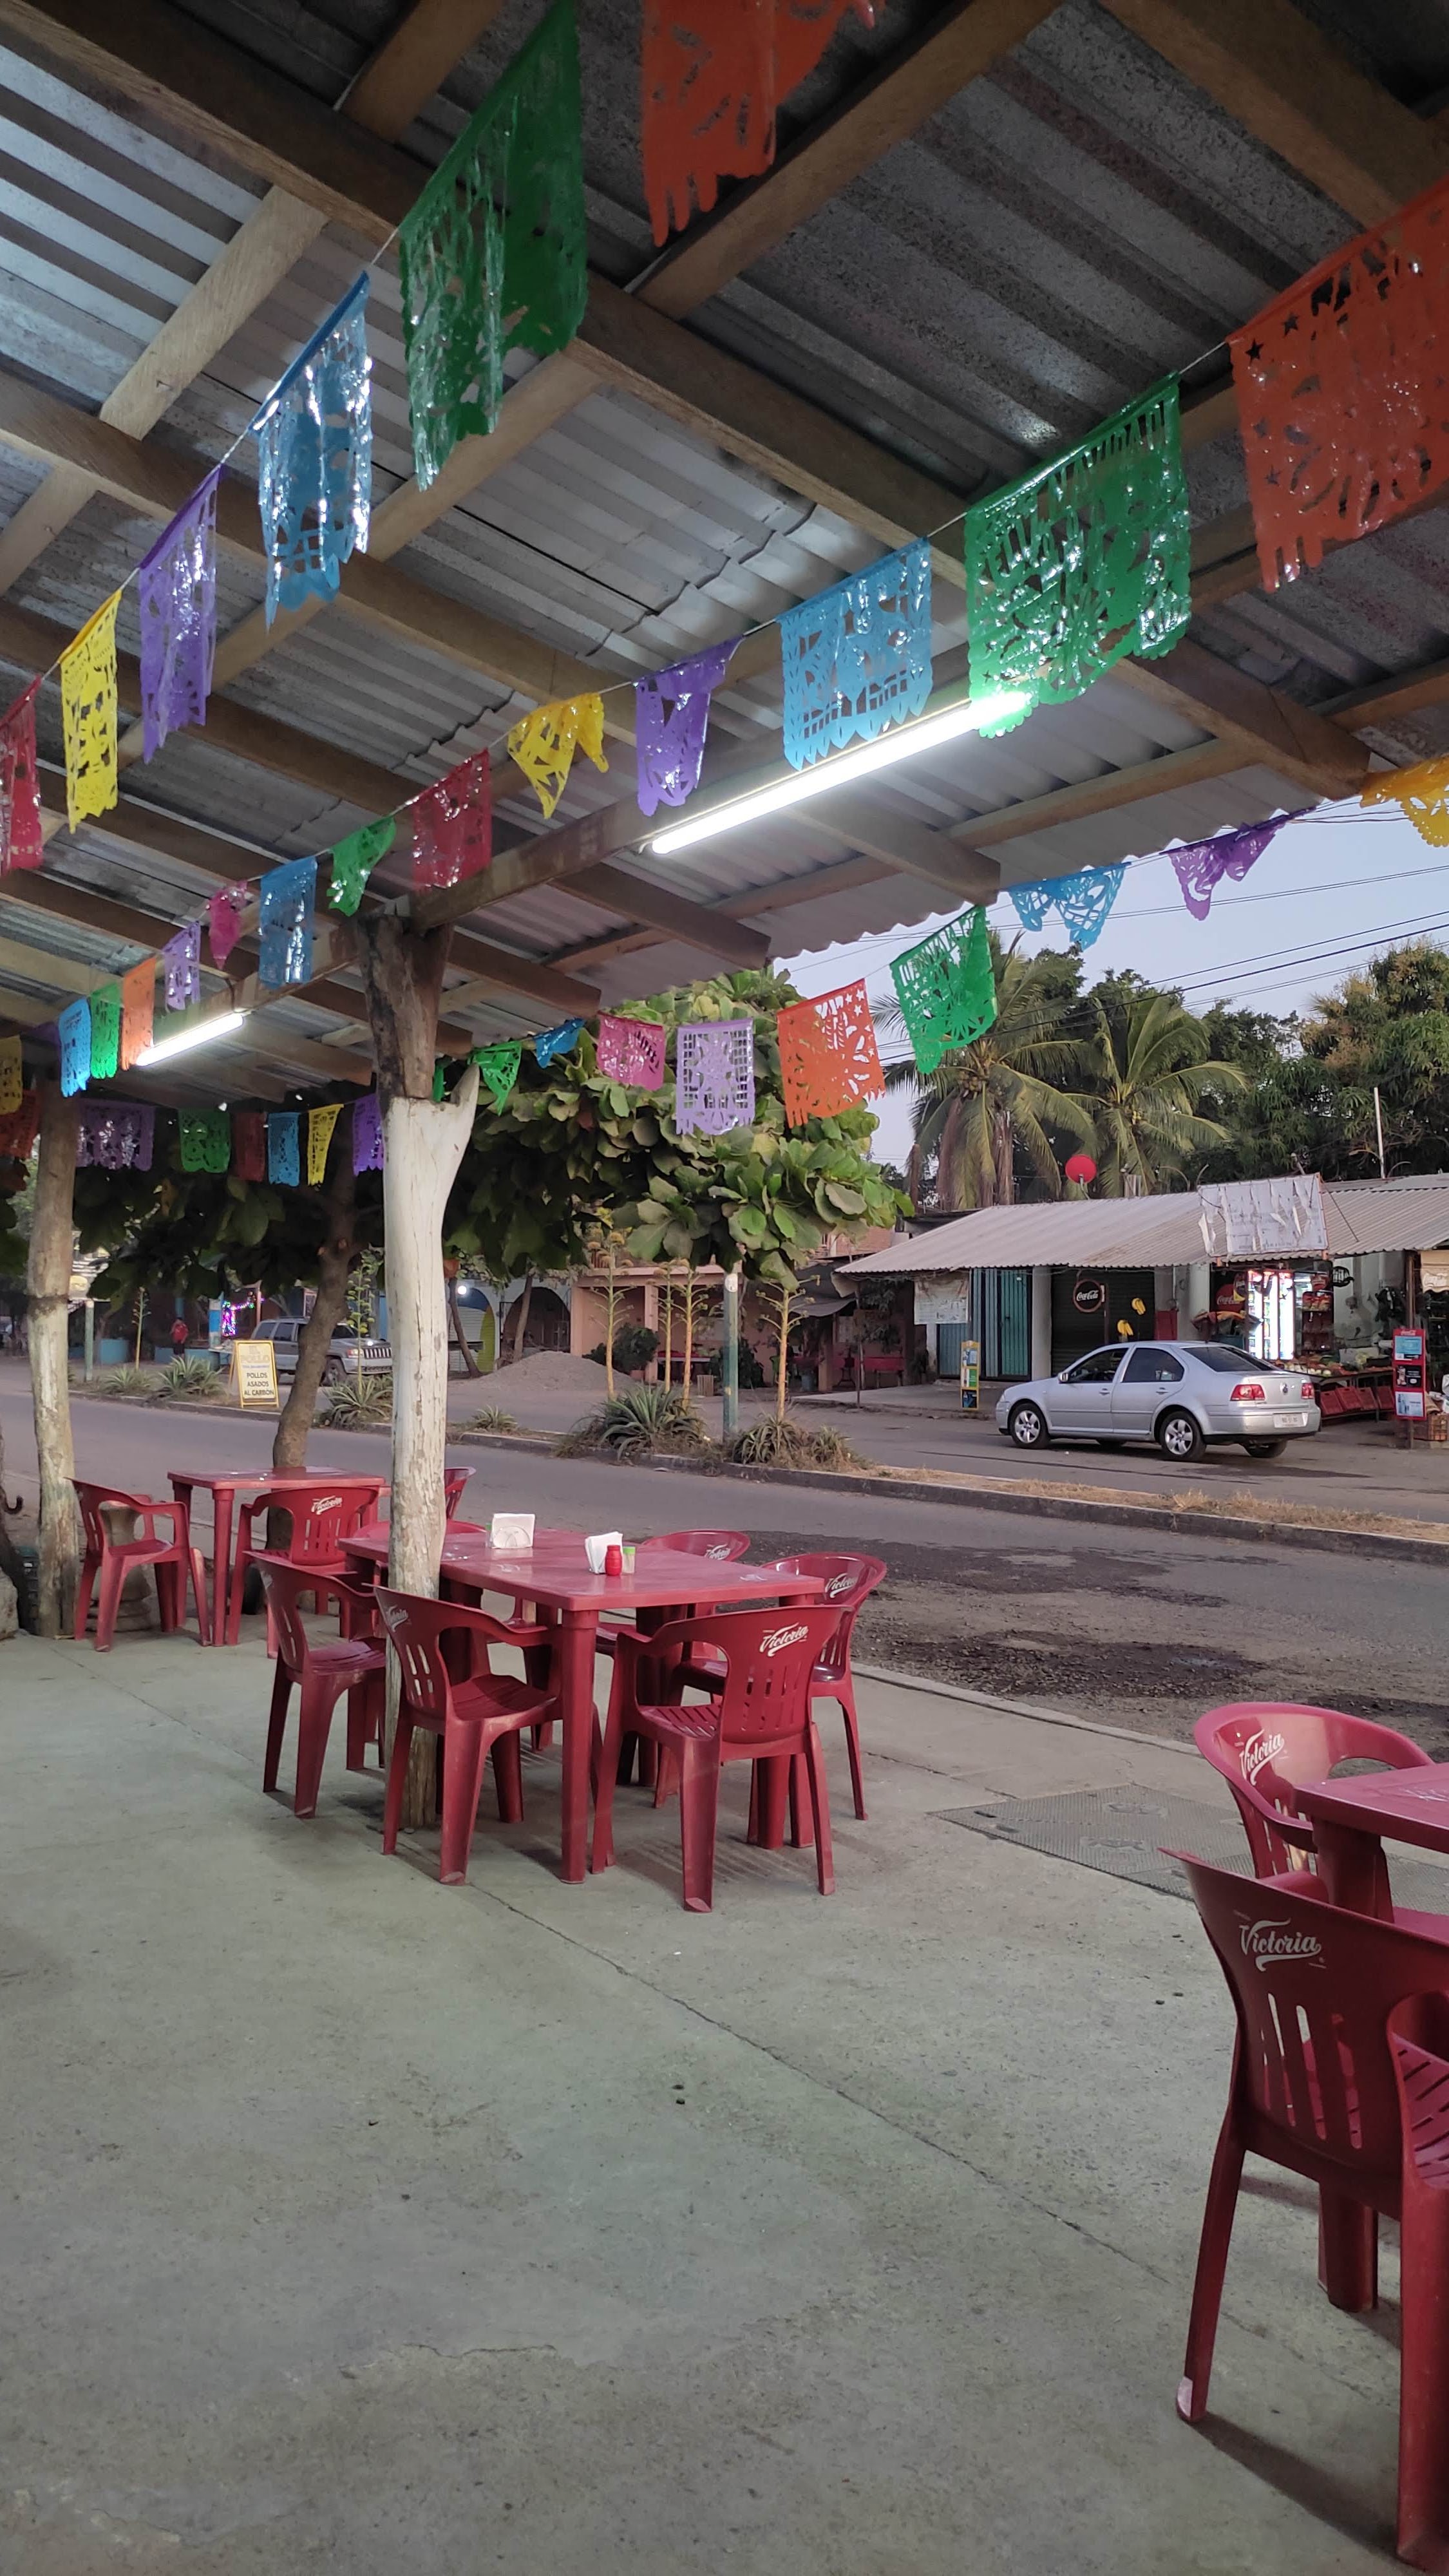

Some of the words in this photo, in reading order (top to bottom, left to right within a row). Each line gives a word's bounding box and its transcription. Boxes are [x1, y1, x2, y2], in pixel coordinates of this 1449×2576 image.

[759, 1622, 809, 1657] Victoria
[1238, 1728, 1284, 1785] Victoria
[1239, 1918, 1322, 1972] Victoria
